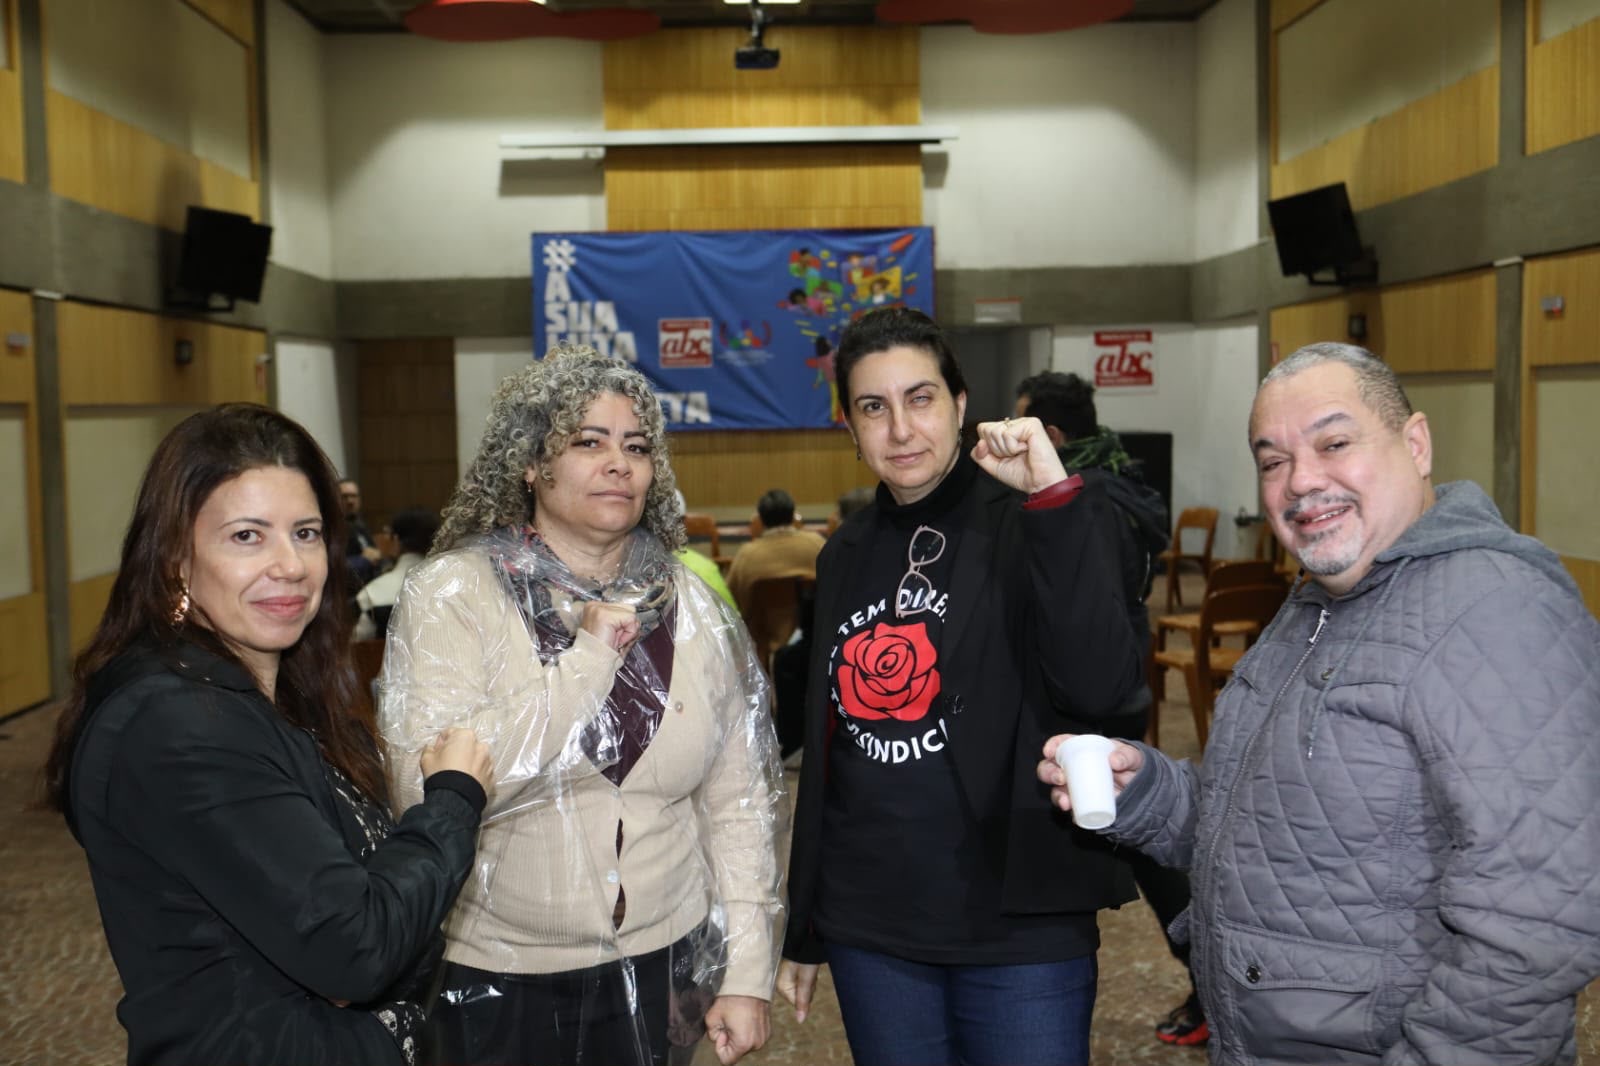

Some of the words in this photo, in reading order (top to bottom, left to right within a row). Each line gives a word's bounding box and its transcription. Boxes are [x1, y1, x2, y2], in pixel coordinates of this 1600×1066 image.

[544, 271, 572, 302] A
[545, 301, 619, 333] SUA
[1095, 346, 1153, 374] abc
[837, 598, 886, 635] TEM
